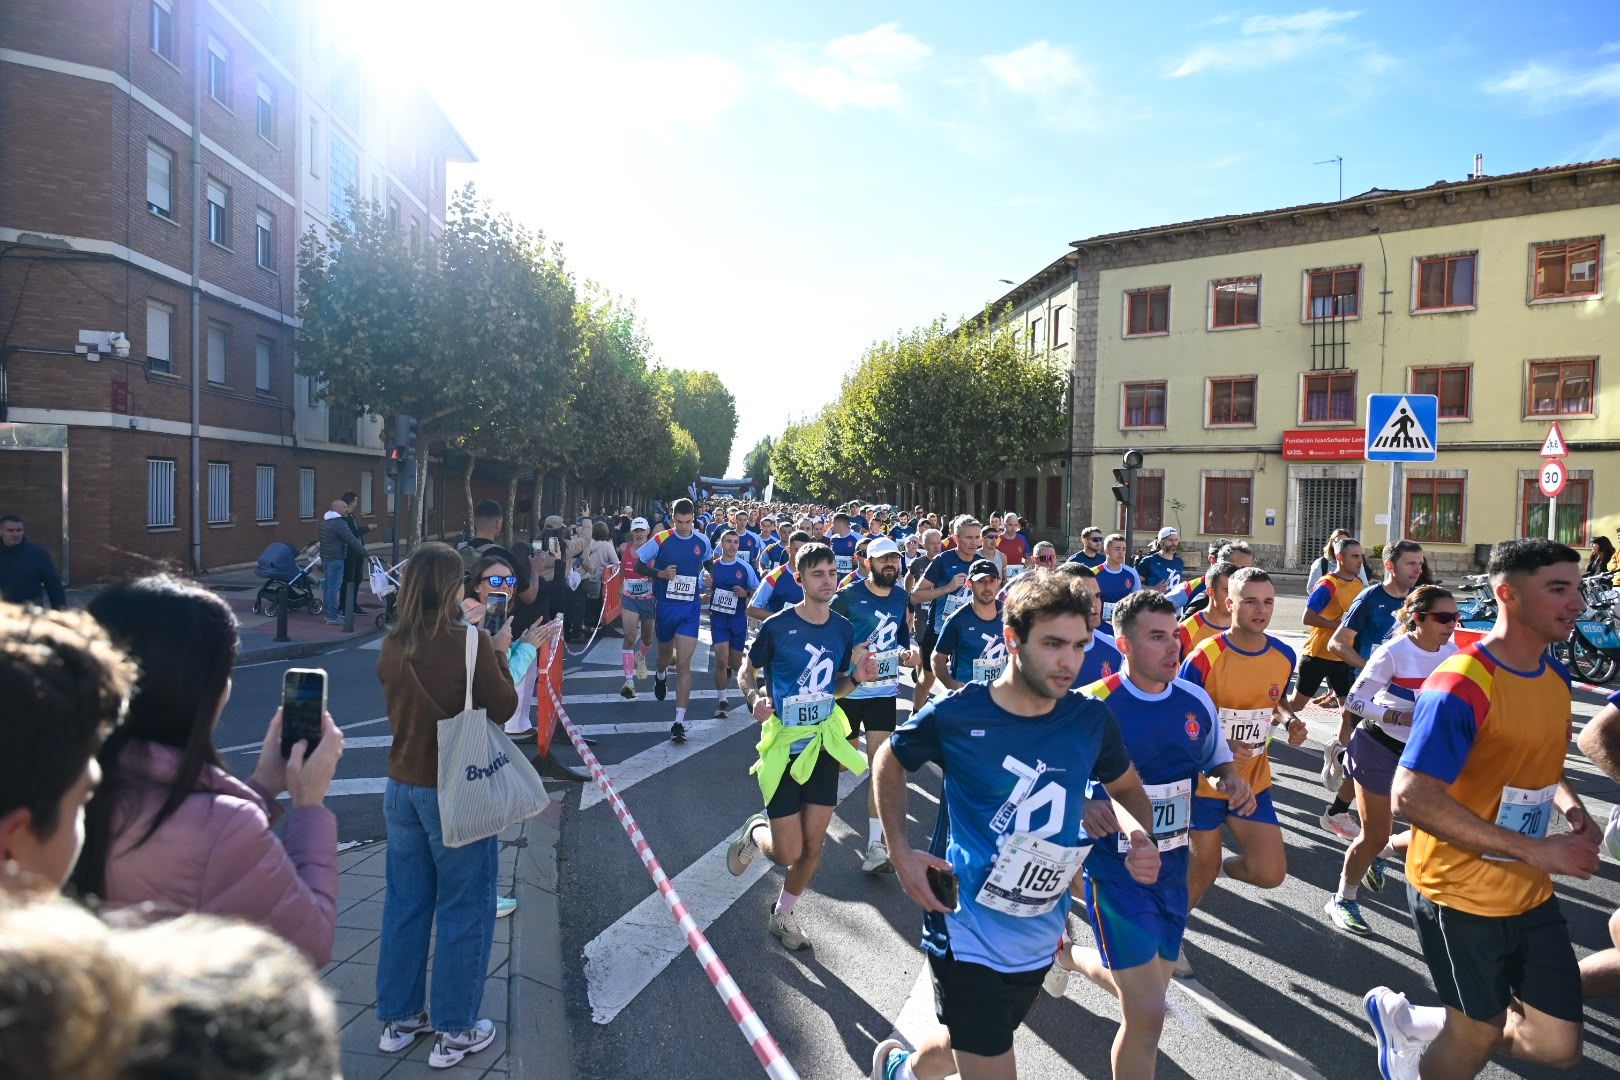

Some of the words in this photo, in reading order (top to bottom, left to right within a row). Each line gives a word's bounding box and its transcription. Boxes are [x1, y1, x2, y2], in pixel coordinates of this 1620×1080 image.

[1322, 469, 1328, 477] 2
[1544, 471, 1559, 484] 30
[673, 581, 690, 592] 1020
[1582, 623, 1603, 633] alsa
[878, 661, 890, 675] 84
[798, 705, 819, 722] 613
[1231, 723, 1260, 741] 1074
[1518, 810, 1543, 835] 210
[1017, 861, 1066, 892] 1195
